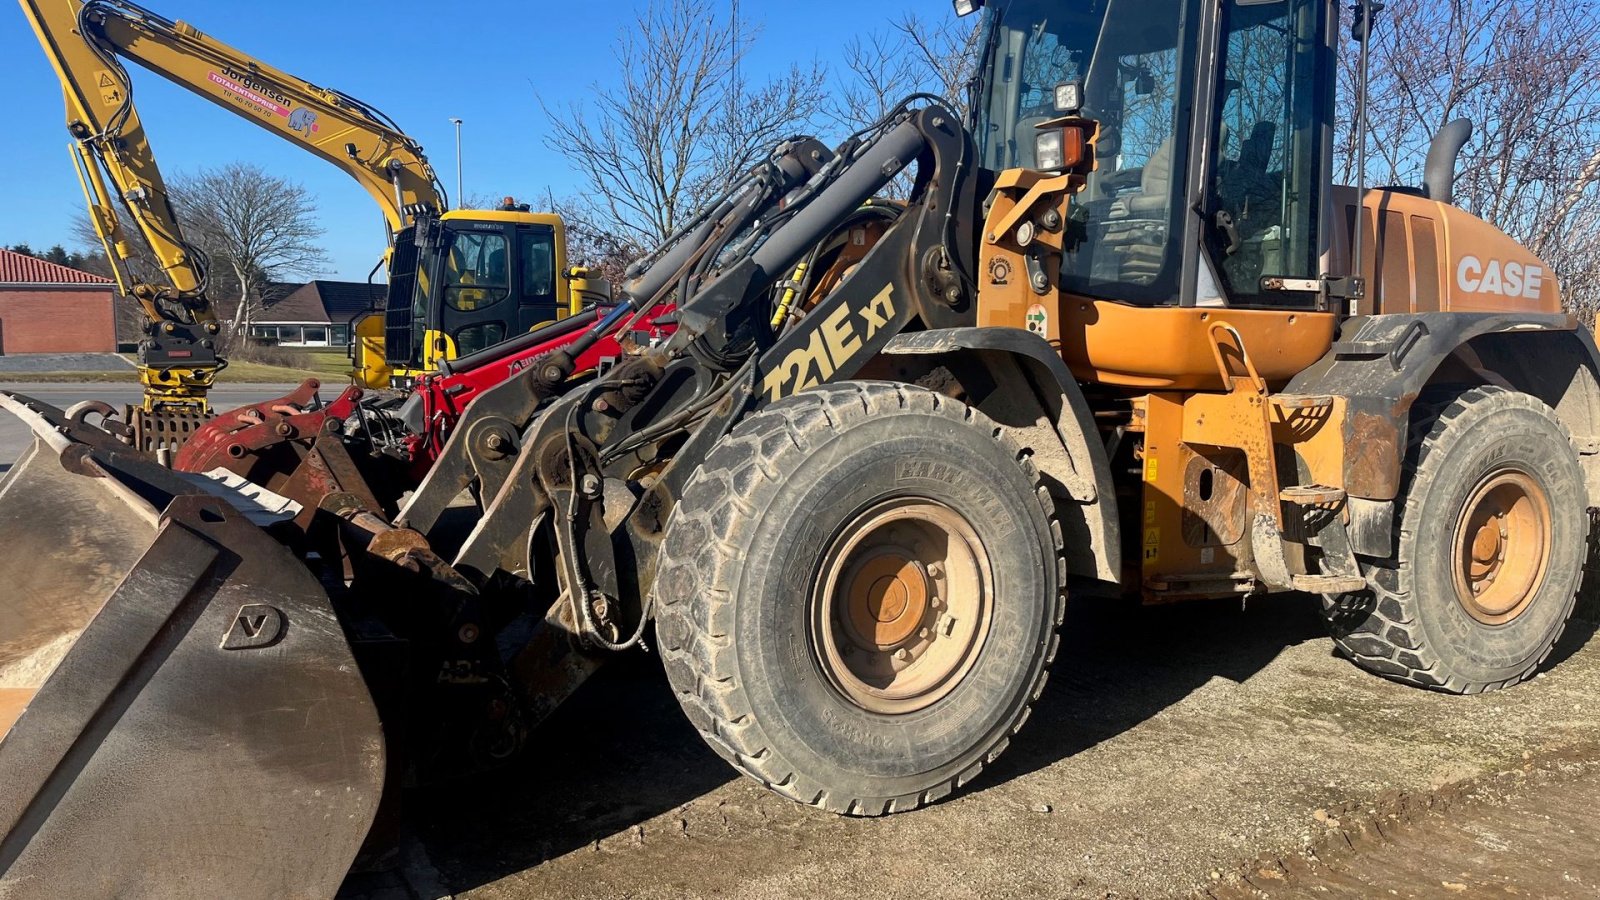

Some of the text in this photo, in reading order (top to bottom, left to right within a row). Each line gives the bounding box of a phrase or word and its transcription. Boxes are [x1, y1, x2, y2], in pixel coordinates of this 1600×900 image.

[211, 73, 279, 112] TOTALENTREPRISE
[234, 96, 243, 104] 40
[244, 100, 253, 108] 70
[262, 109, 272, 118] 70
[1456, 255, 1542, 299] CASE
[763, 282, 896, 403] 721E XT
